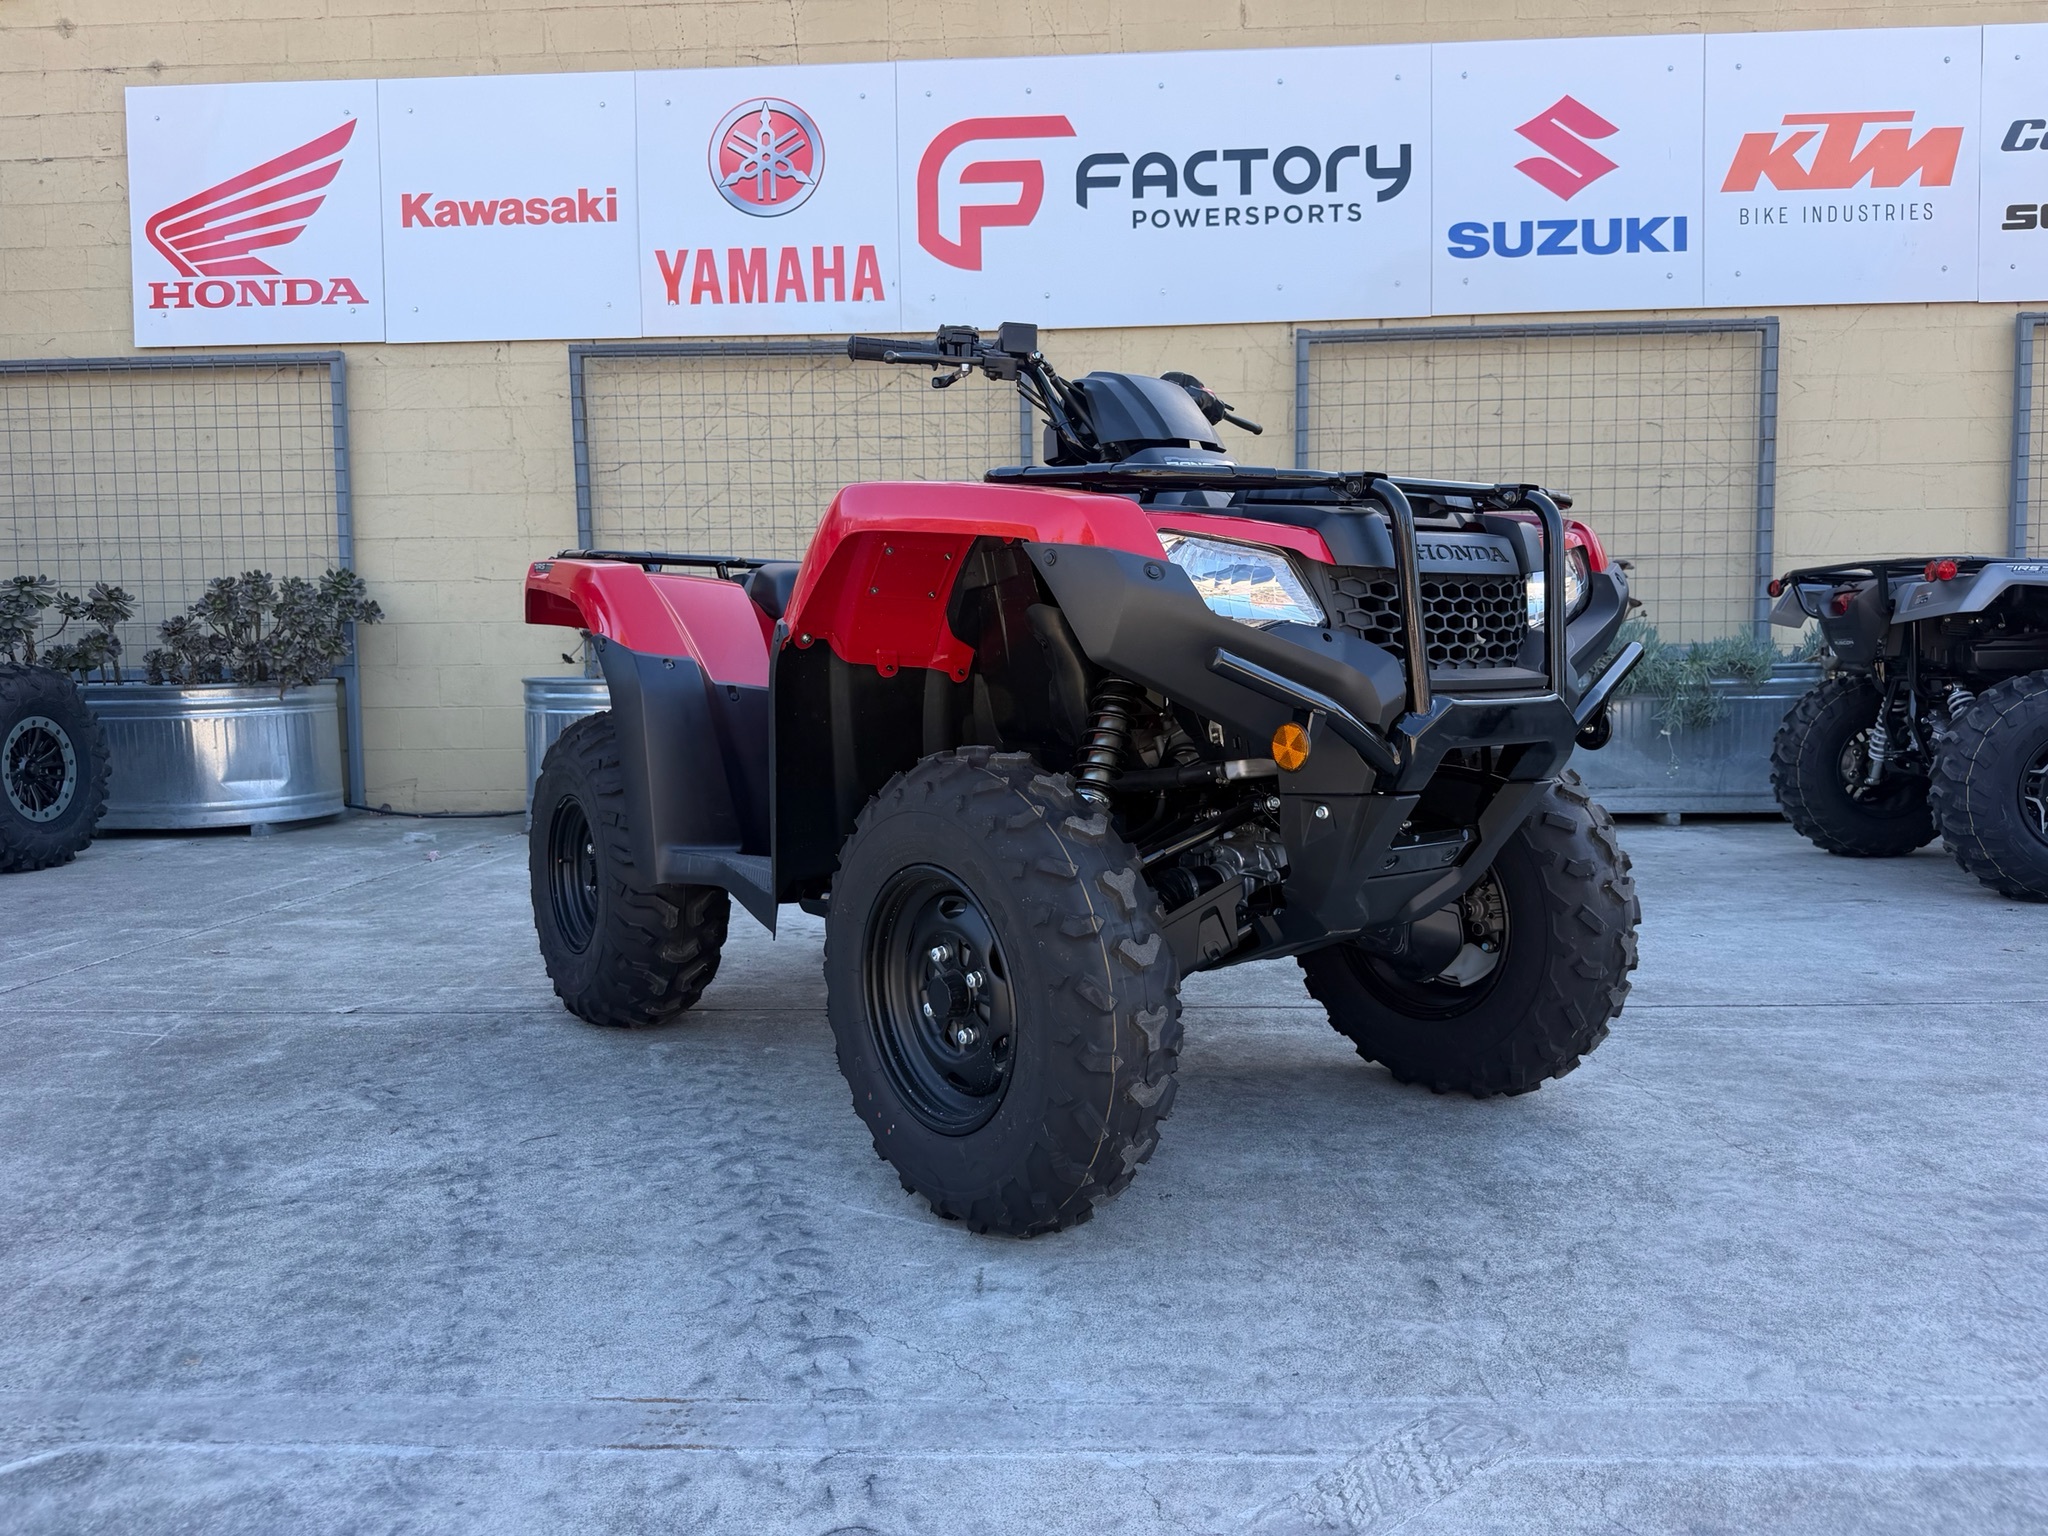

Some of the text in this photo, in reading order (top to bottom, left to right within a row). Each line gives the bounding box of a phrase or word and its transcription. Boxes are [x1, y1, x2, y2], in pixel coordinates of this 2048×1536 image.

[1720, 111, 1965, 192] KTM
[1076, 144, 1412, 209] FACTORY
[402, 188, 617, 228] Kawasaki
[1133, 203, 1362, 229] POWERSPORTS
[1740, 203, 1933, 225] BIKE INDUSTRIES
[1447, 216, 1688, 259] SUZUKI
[148, 278, 369, 309] HONDA
[655, 246, 885, 305] YAMAHA
